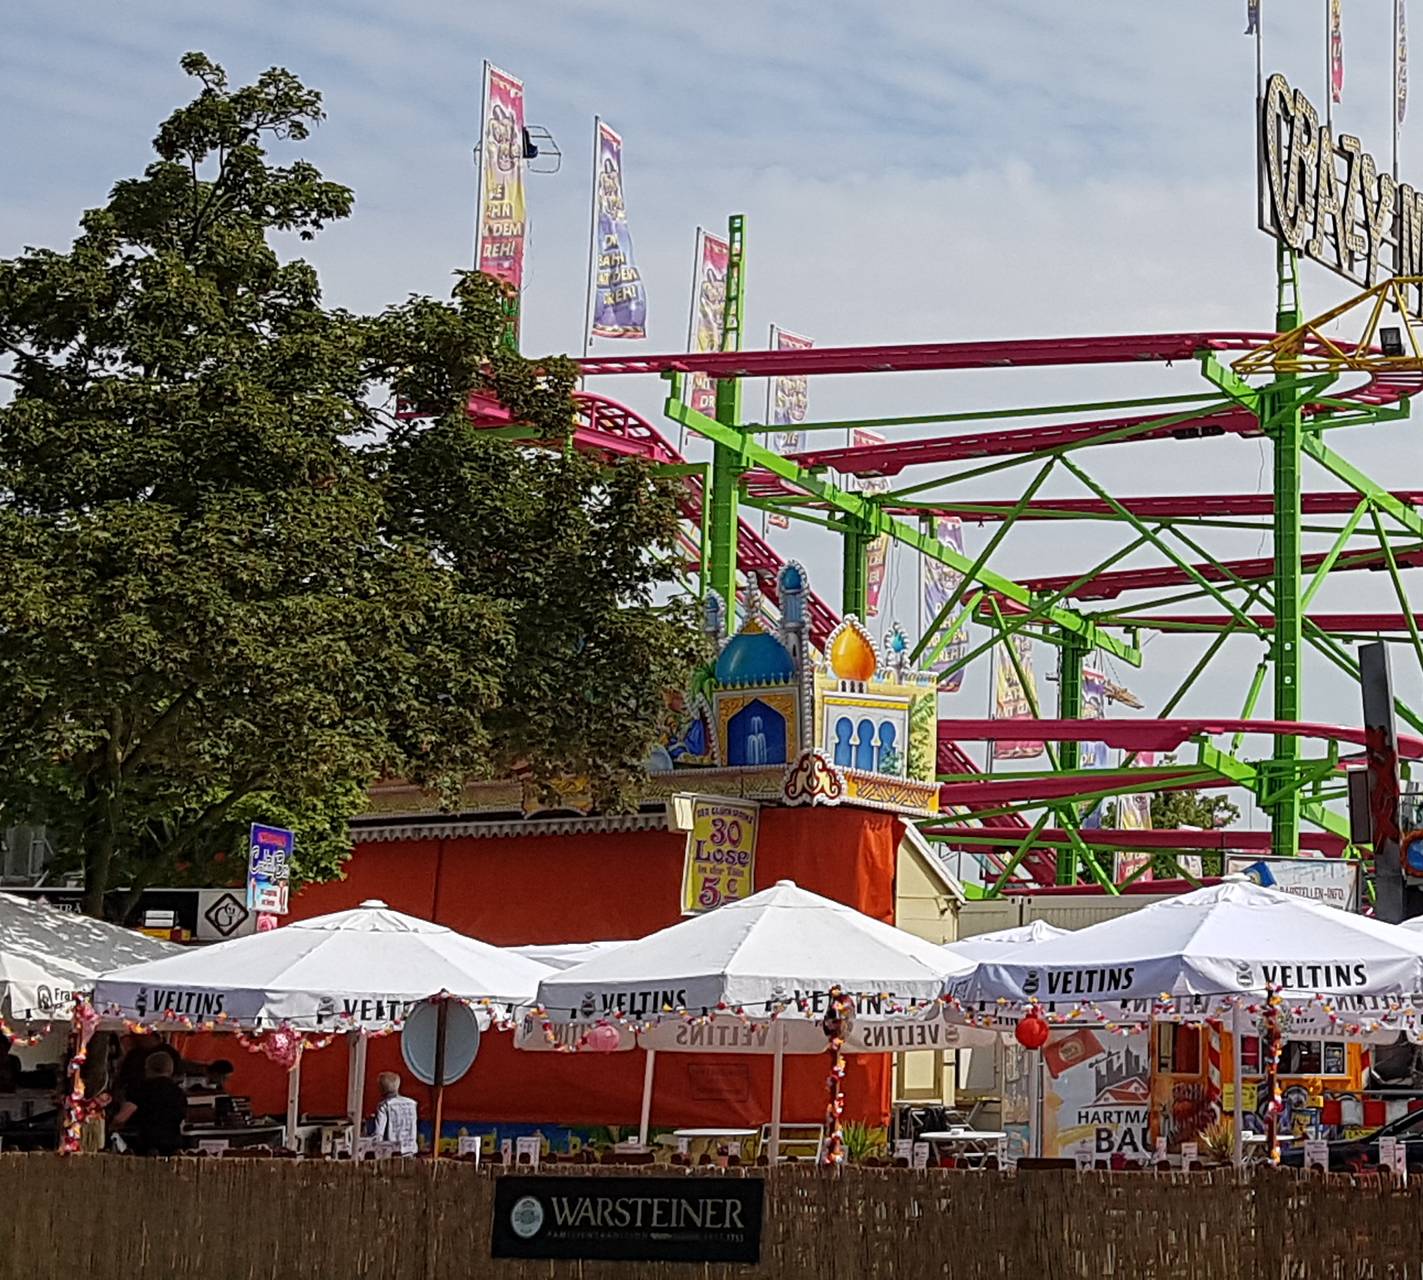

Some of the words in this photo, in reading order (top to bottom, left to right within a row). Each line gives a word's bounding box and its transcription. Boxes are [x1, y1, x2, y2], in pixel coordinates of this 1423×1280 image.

[1265, 72, 1396, 290] CRAZY
[711, 818, 742, 848] 30
[695, 840, 750, 866] Lose
[699, 877, 721, 907] 5
[1048, 967, 1135, 995] VELTINS
[1262, 964, 1367, 989] VELTINS
[153, 990, 225, 1014] VELTINS
[601, 989, 687, 1014] VELTINS
[794, 990, 897, 1015] VEINS
[551, 1196, 745, 1229] WARSTEINER
